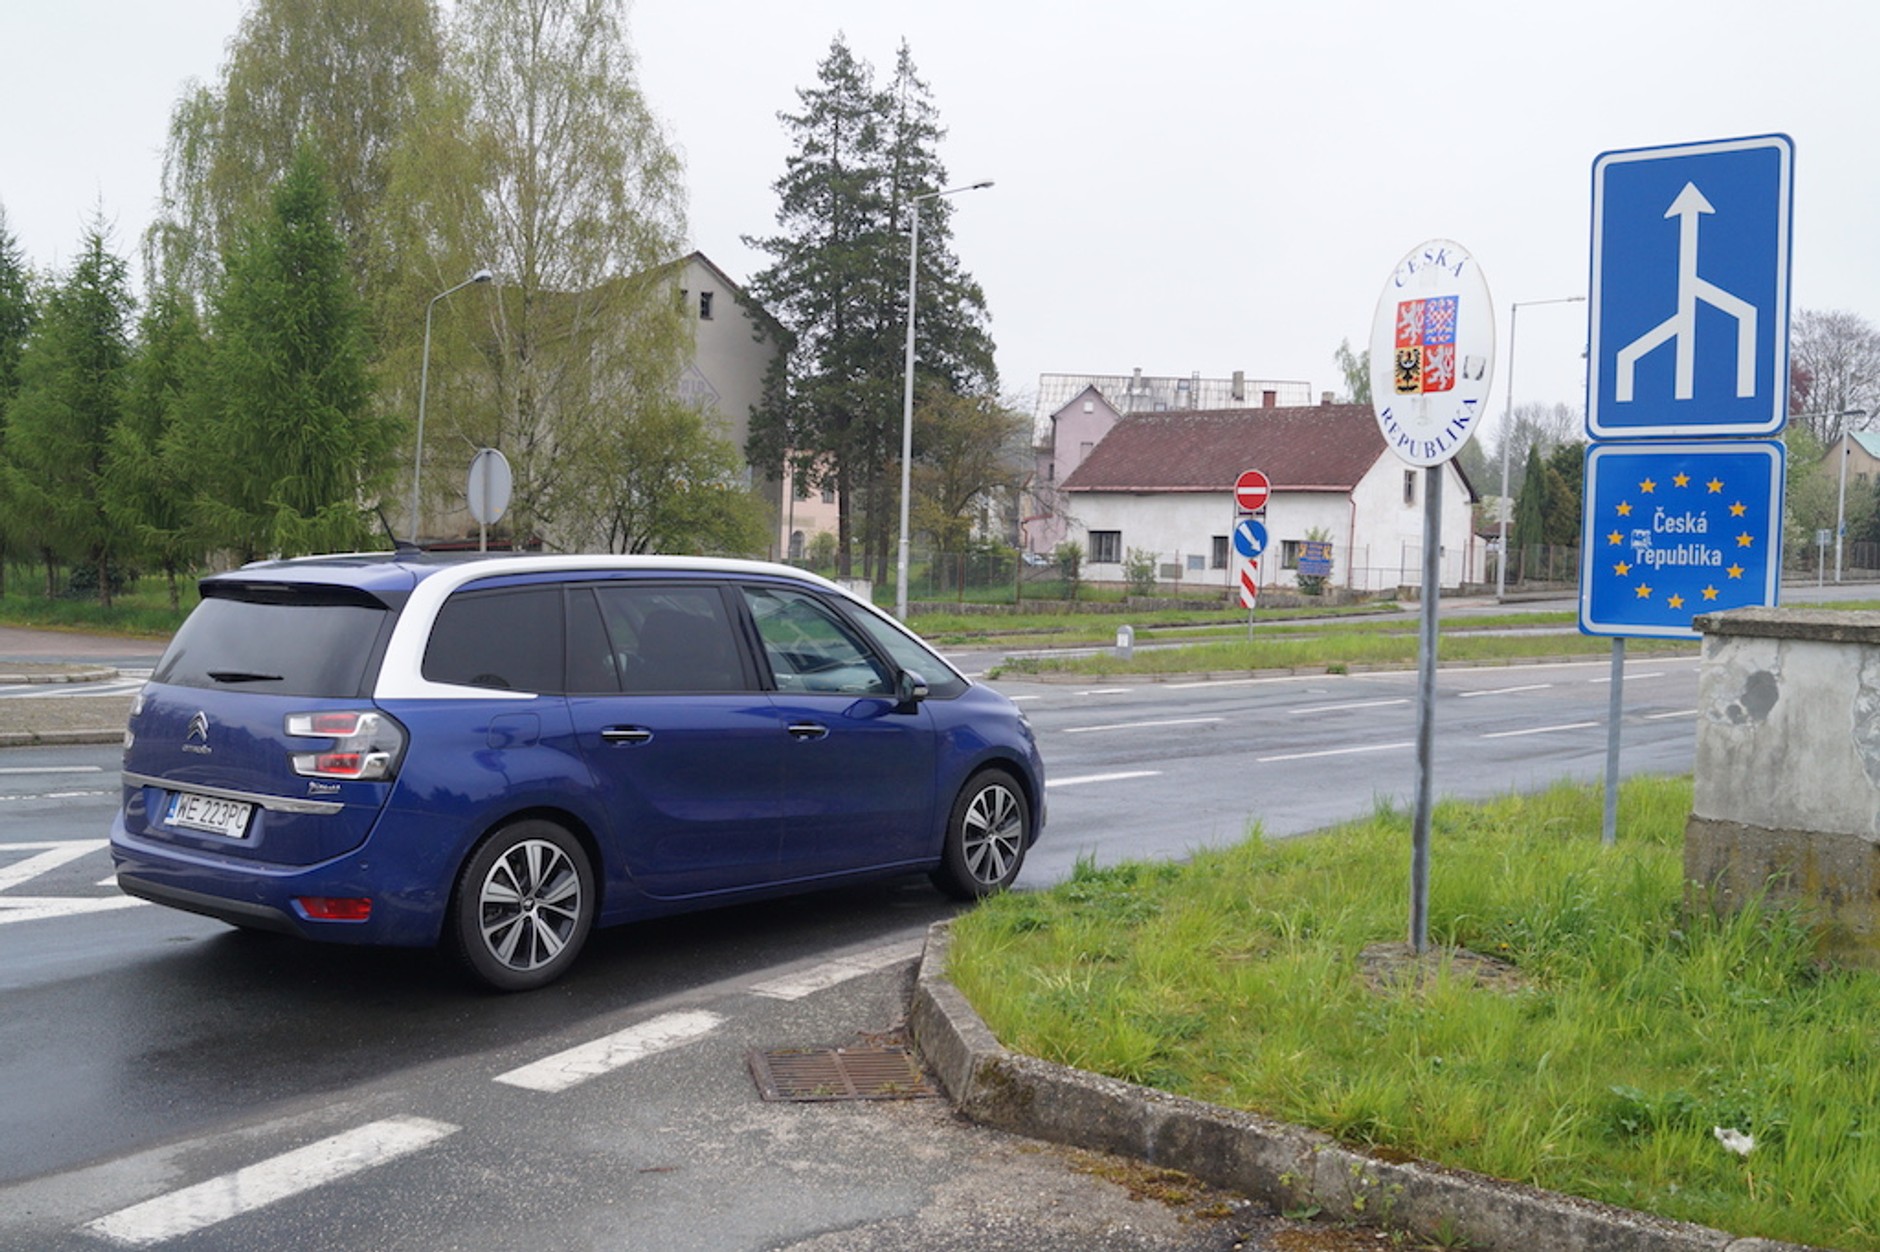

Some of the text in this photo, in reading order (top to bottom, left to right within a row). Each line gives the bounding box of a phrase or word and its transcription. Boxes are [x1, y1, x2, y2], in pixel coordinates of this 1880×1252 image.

[1381, 399, 1478, 459] REPUBLIKA
[1654, 506, 1708, 533] Česká
[1636, 544, 1723, 570] republika
[176, 793, 200, 821] WE
[200, 800, 249, 830] 223PC
